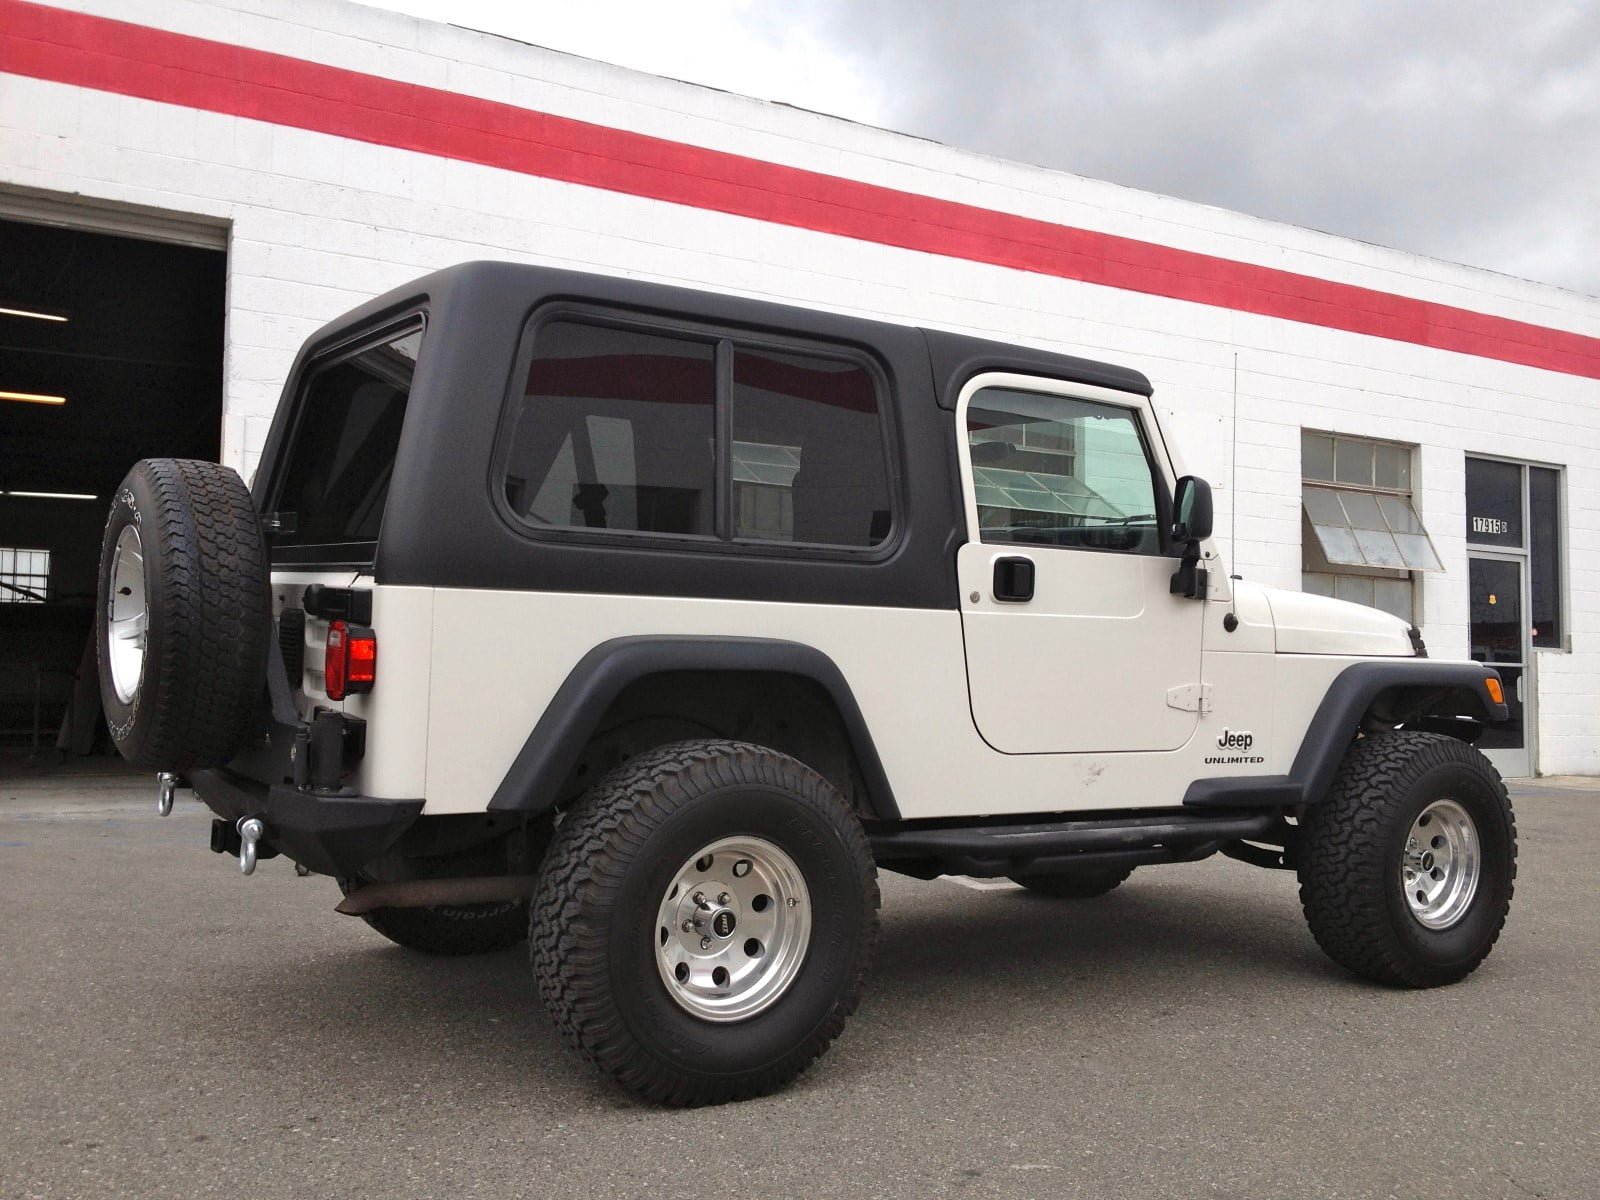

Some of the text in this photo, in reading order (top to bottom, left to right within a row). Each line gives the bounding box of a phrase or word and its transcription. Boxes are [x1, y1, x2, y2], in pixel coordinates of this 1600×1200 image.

[1473, 517, 1500, 533] 17915
[1218, 730, 1253, 751] Jeep
[1204, 756, 1265, 765] UNLIMITED
